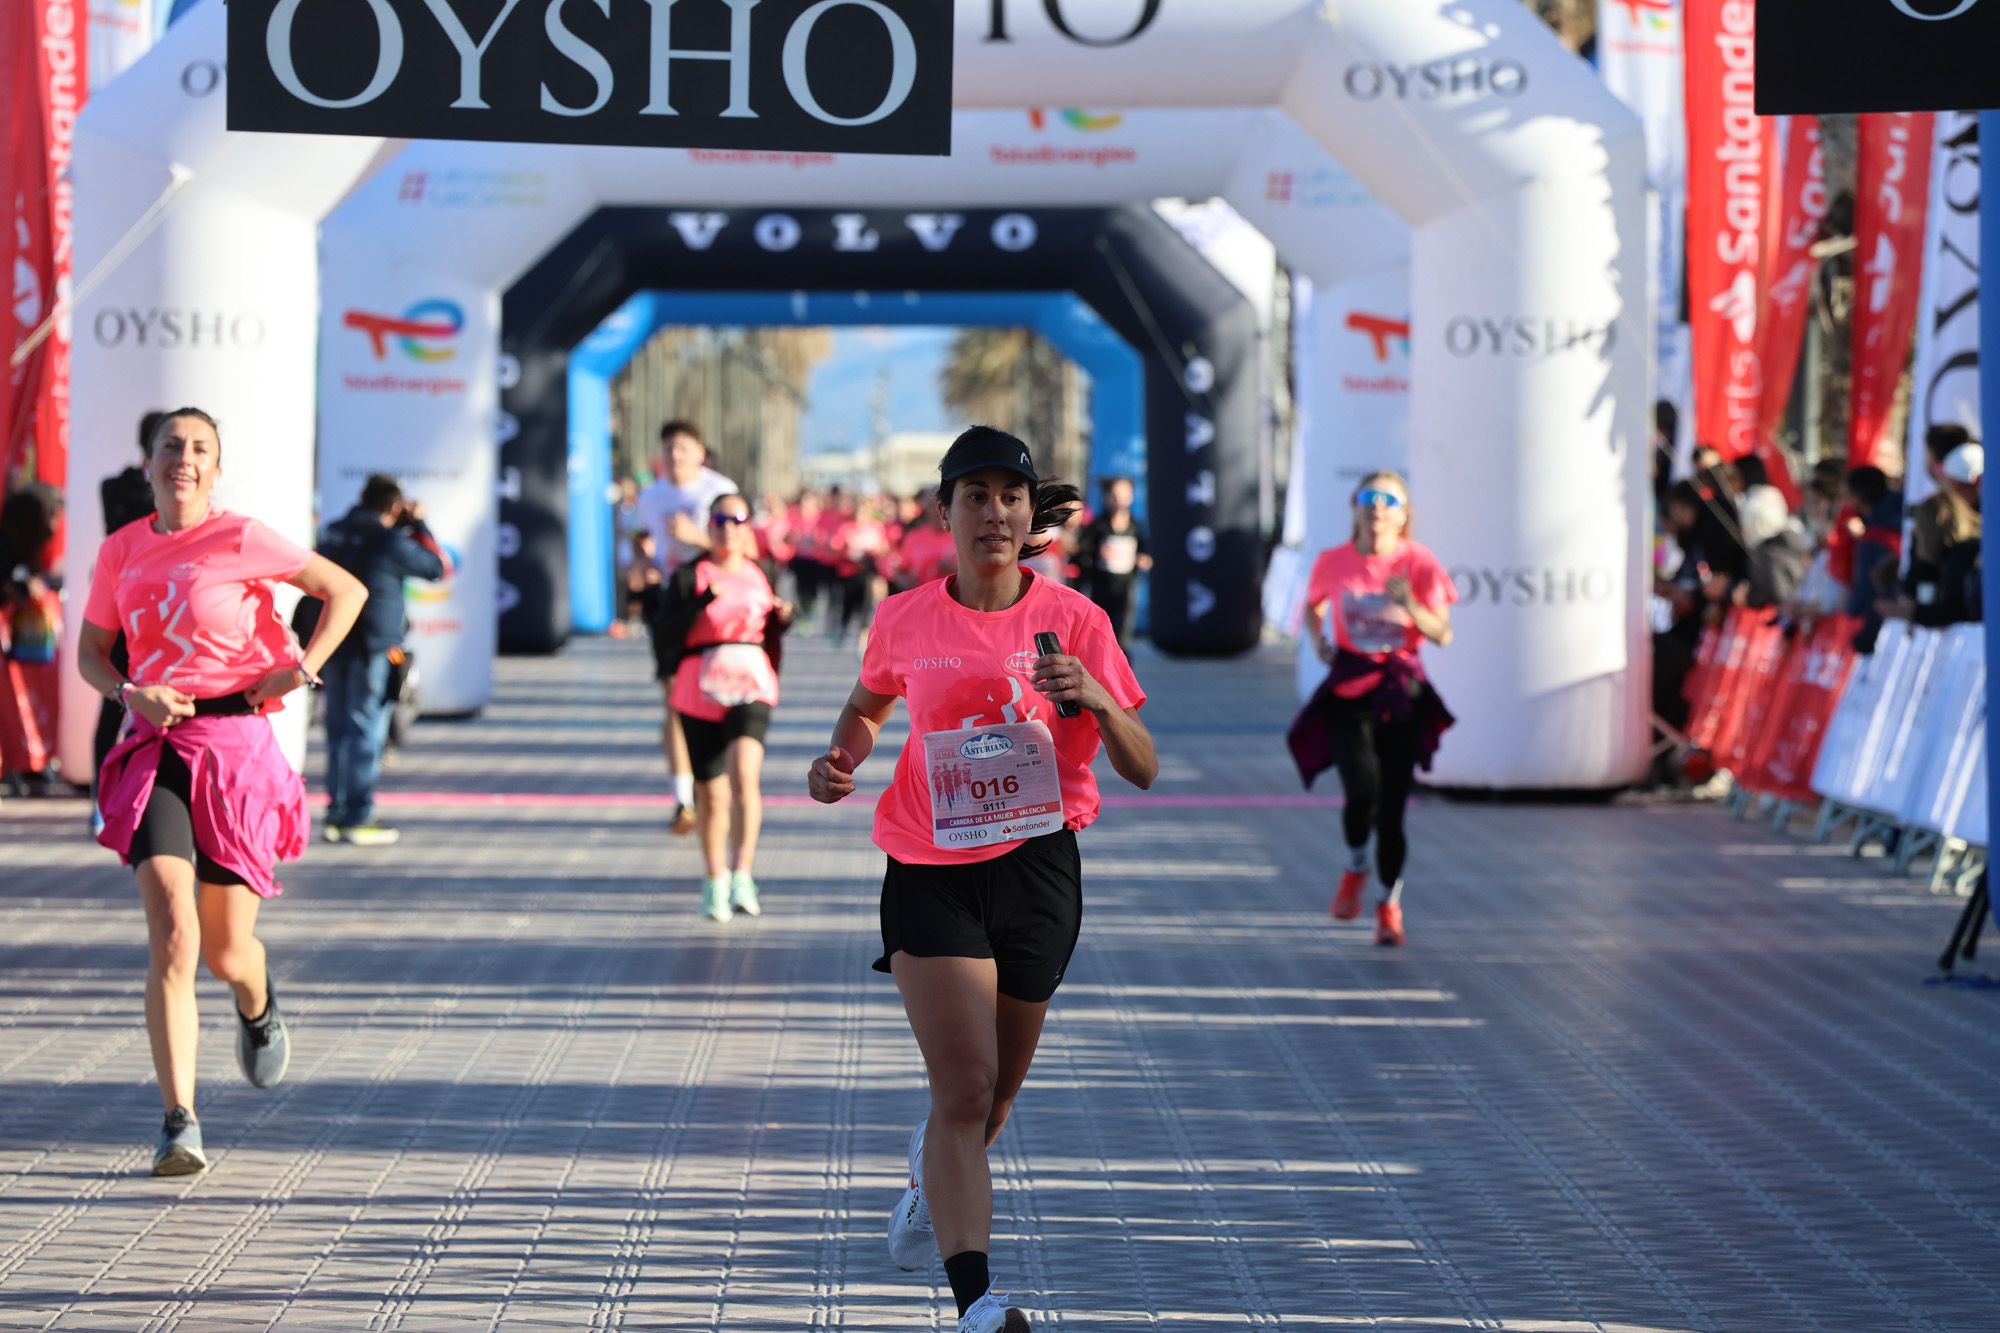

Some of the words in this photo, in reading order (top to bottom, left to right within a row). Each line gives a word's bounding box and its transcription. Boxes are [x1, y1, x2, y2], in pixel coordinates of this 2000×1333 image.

[266, 0, 918, 126] OYSHO
[1344, 58, 1528, 101] OYSHO
[41, 0, 77, 263] Santande
[1714, 0, 1763, 265] Santande
[669, 212, 1039, 252] VOLVO
[94, 306, 267, 350] OYSHO
[1184, 357, 1217, 623] VOLVO
[1448, 563, 1617, 607] OYSHO
[913, 656, 962, 671] OYSHO
[964, 742, 1010, 756] ASTURIANA
[970, 775, 1020, 800] 016
[983, 801, 1006, 812] 9111
[949, 818, 974, 826] CARRERA
[984, 815, 992, 823] LA
[993, 812, 1014, 821] MUJER
[1018, 806, 1047, 816] VALENCIA
[949, 829, 988, 842] OYSHO
[1012, 820, 1050, 833] Santander
